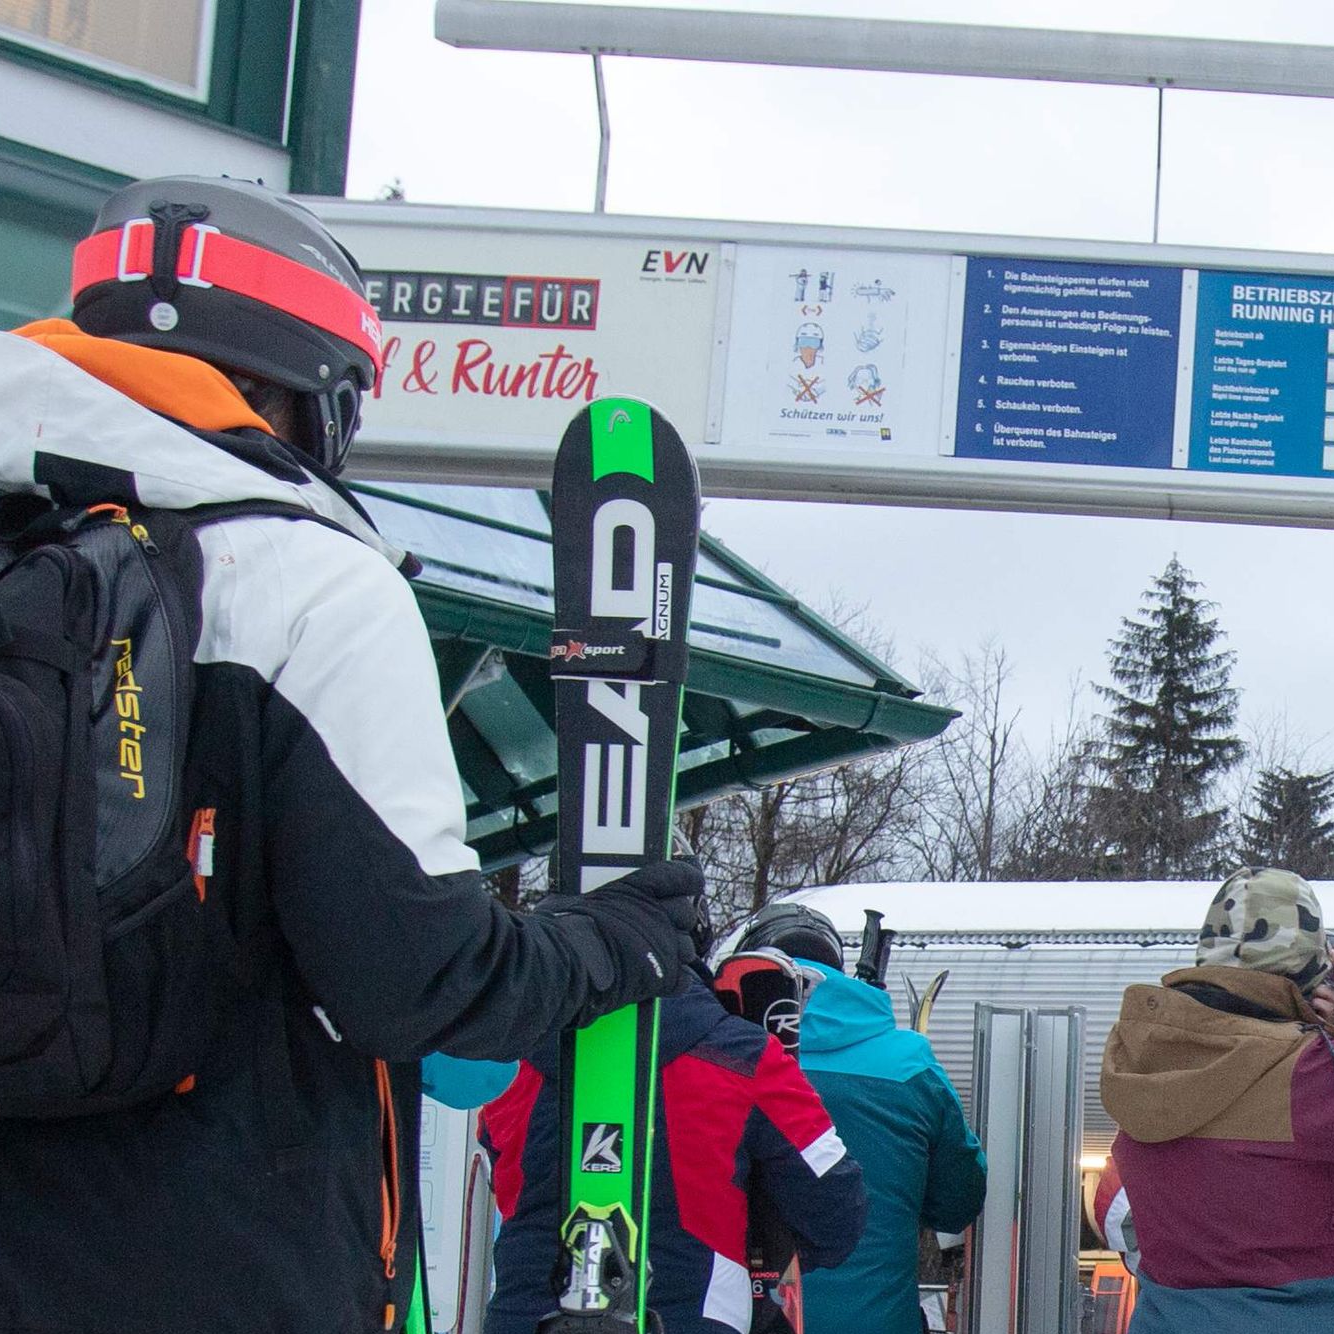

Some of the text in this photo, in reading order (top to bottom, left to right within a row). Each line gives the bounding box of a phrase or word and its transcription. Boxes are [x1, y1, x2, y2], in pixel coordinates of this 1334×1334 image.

[642, 250, 709, 274] EVN
[987, 270, 1149, 288] 1. Die Bahnsteigsperren dürfen nicht
[1004, 283, 1133, 298] eigenmächtig geöffnet werden.
[510, 284, 595, 322] FÜR
[984, 304, 992, 313] 2.
[1002, 305, 1019, 314] Den
[1021, 306, 1079, 320] Anweisungen
[1080, 310, 1096, 319] des
[1232, 303, 1315, 323] RUNNING
[1001, 318, 1172, 337] personals ist unbedingt Folge zu leisten.
[982, 340, 1127, 356] 3. Eigenmächtiges Einsteigen ist
[998, 352, 1039, 363] verboten.
[403, 336, 439, 395] &
[451, 336, 601, 401] Runter
[979, 375, 1077, 390] 4. Rauchen verboten.
[780, 408, 884, 423] Schützen wir uns!
[977, 400, 1082, 414] 5. Schaukeln verboten.
[975, 422, 1117, 442] 6. Überqueren des Bahnsteiges
[993, 437, 1046, 448] ist verboten.
[658, 573, 670, 640] AGNUM
[581, 499, 656, 895] EAD
[110, 637, 146, 800] redster
[581, 1163, 621, 1173] KERS
